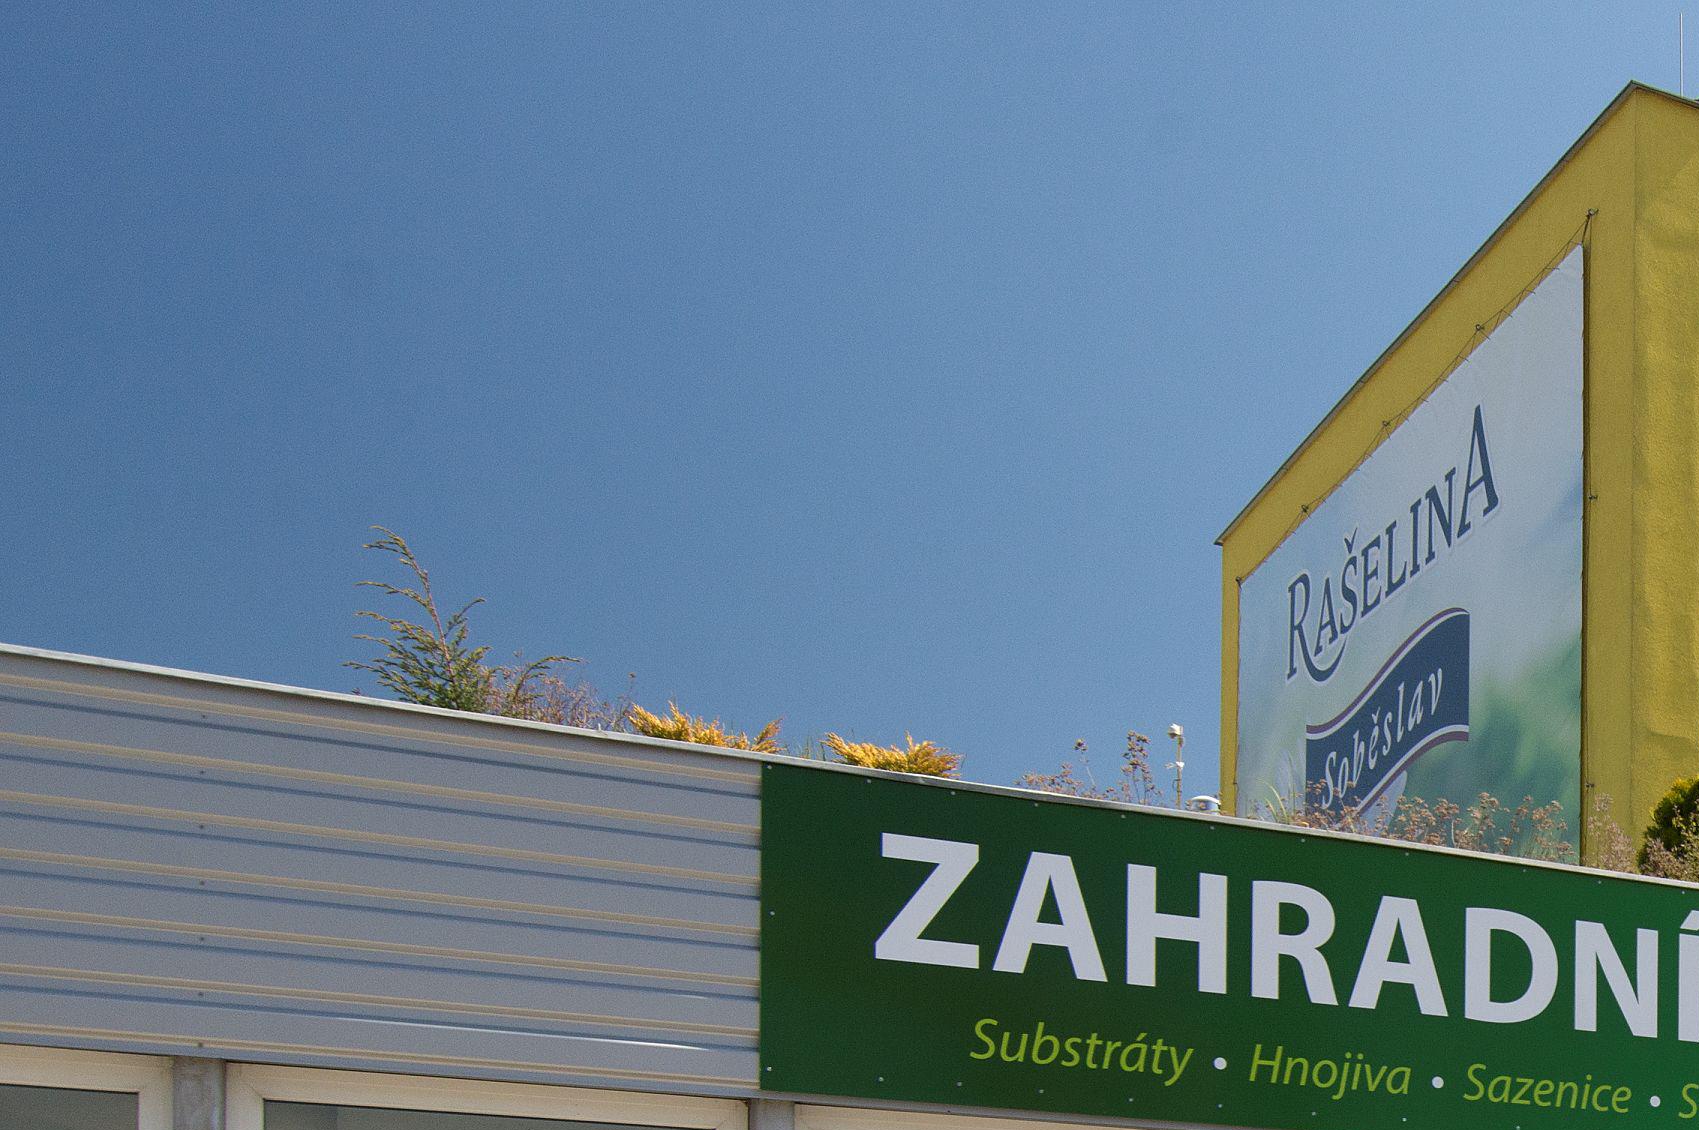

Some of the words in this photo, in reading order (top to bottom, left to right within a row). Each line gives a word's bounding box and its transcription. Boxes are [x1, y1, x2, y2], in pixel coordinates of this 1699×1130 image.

[1322, 667, 1443, 809] Soběslav
[969, 1017, 1194, 1087] Substráty
[1249, 1043, 1412, 1100] Hnojiva
[1464, 1062, 1632, 1113] Sazenice
